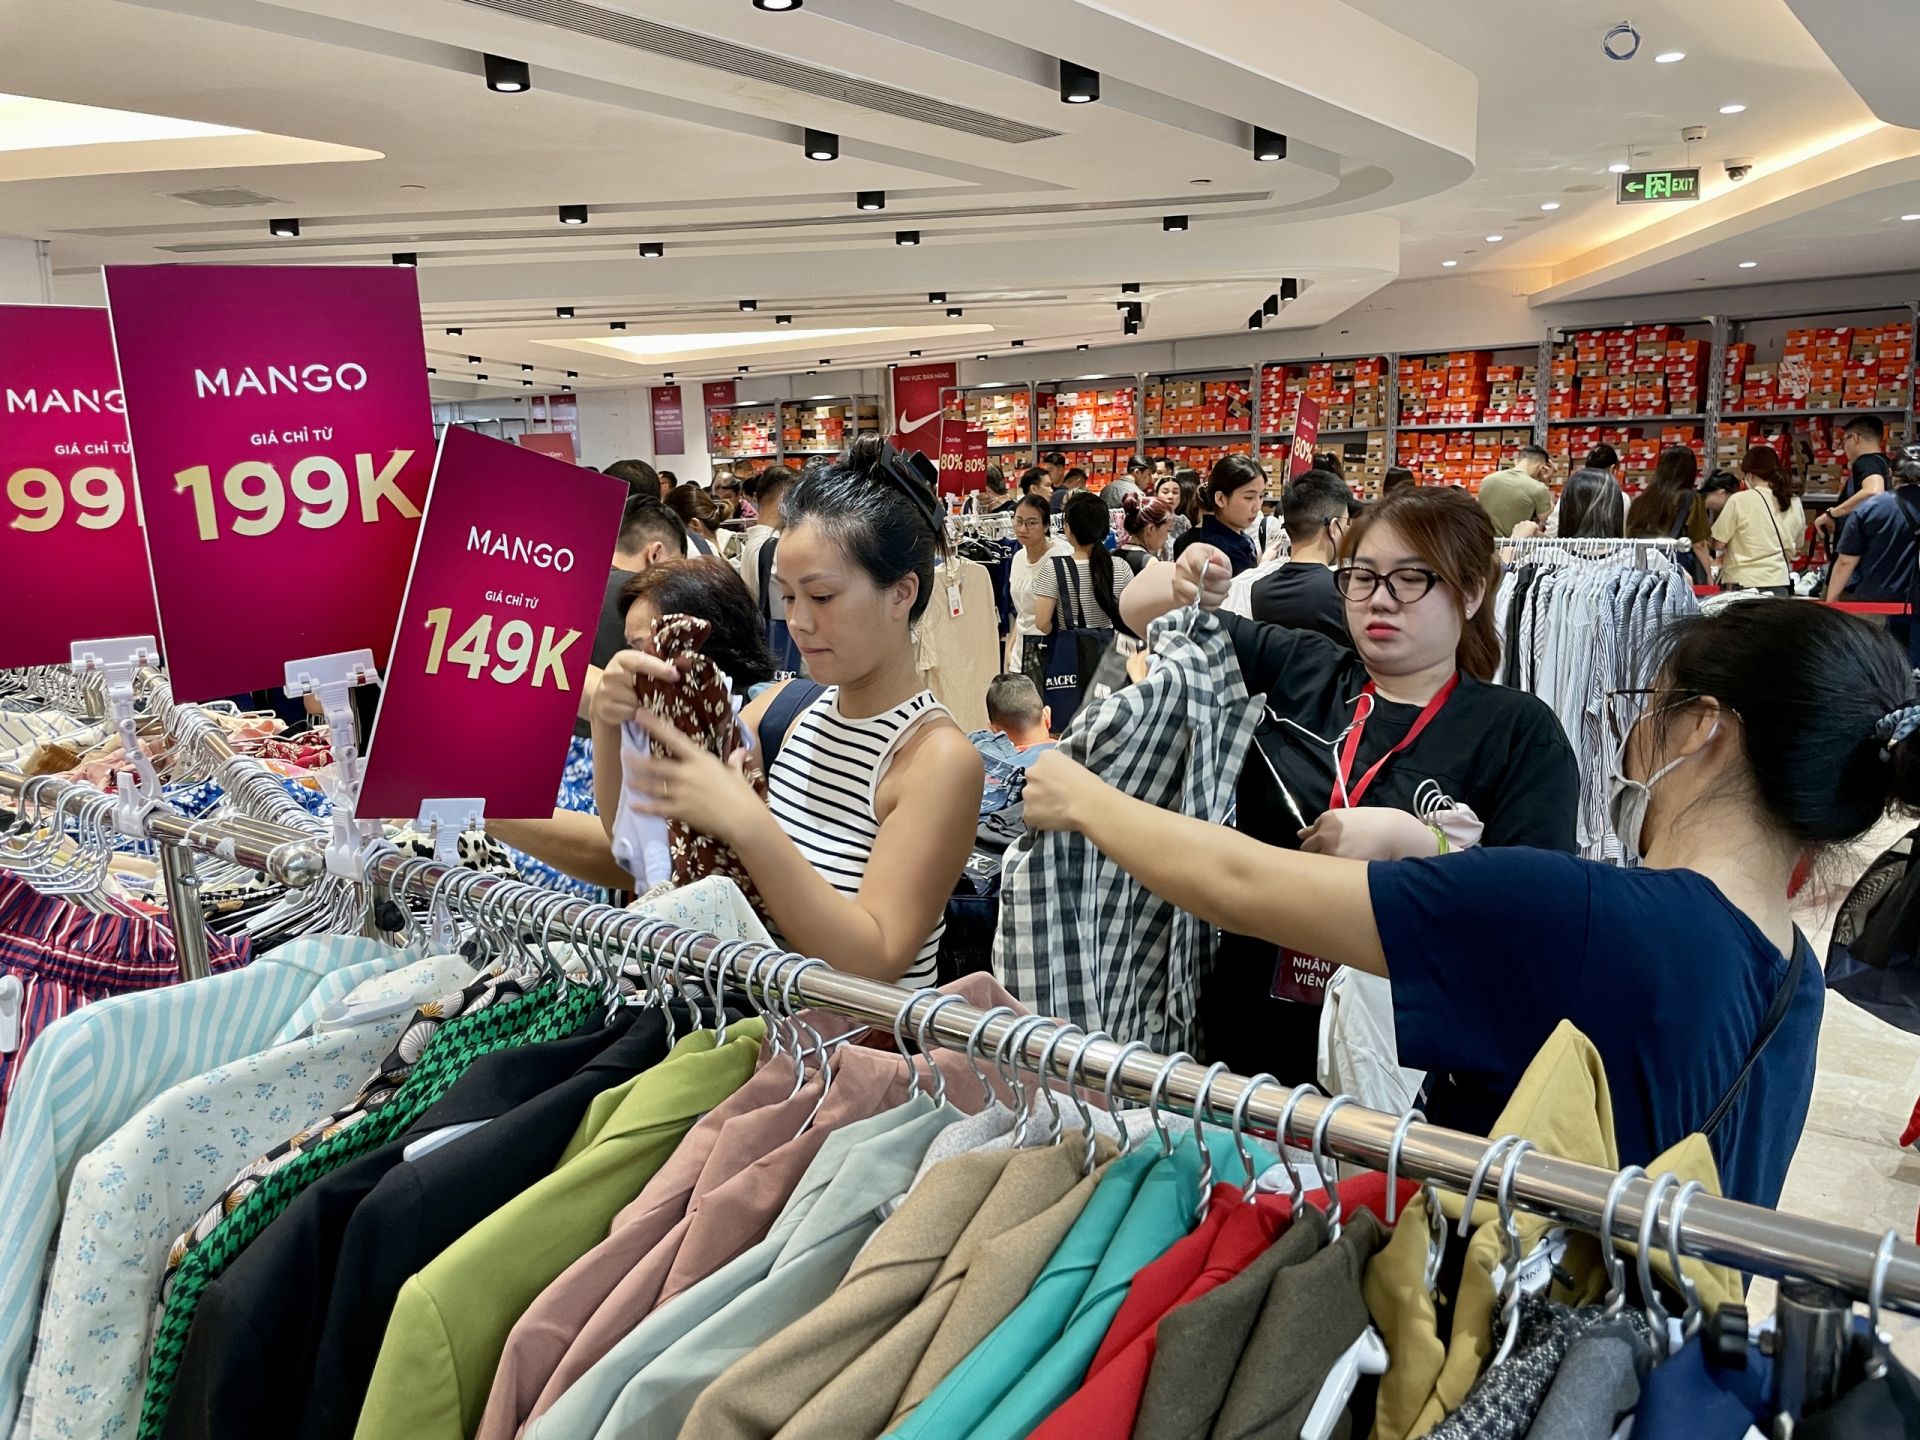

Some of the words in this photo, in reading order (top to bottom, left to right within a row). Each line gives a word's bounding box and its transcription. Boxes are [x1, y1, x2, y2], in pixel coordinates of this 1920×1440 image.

[1671, 177, 1695, 192] EXIT
[194, 362, 368, 398] MANGO
[6, 388, 127, 414] MANG
[250, 430, 279, 446] GIÁ
[282, 426, 309, 443] CHỈ
[312, 427, 333, 441] TỪ
[54, 442, 81, 455] GIÁ
[84, 441, 109, 455] CHỈ
[112, 442, 132, 454] TỪ
[1294, 435, 1314, 464] 80%
[940, 453, 963, 470] 80%
[964, 457, 986, 473] 80%
[7, 466, 144, 533] 99
[172, 449, 423, 541] 199K
[466, 525, 574, 573] MANGO
[485, 590, 503, 603] GIÁ
[505, 593, 524, 607] CHỈ
[525, 597, 539, 609] TỪ
[424, 607, 583, 691] 149K
[774, 670, 797, 681] CFC
[1050, 674, 1077, 685] ACFC
[1292, 956, 1331, 973] NHÂN
[1294, 972, 1325, 988] VIÊN
